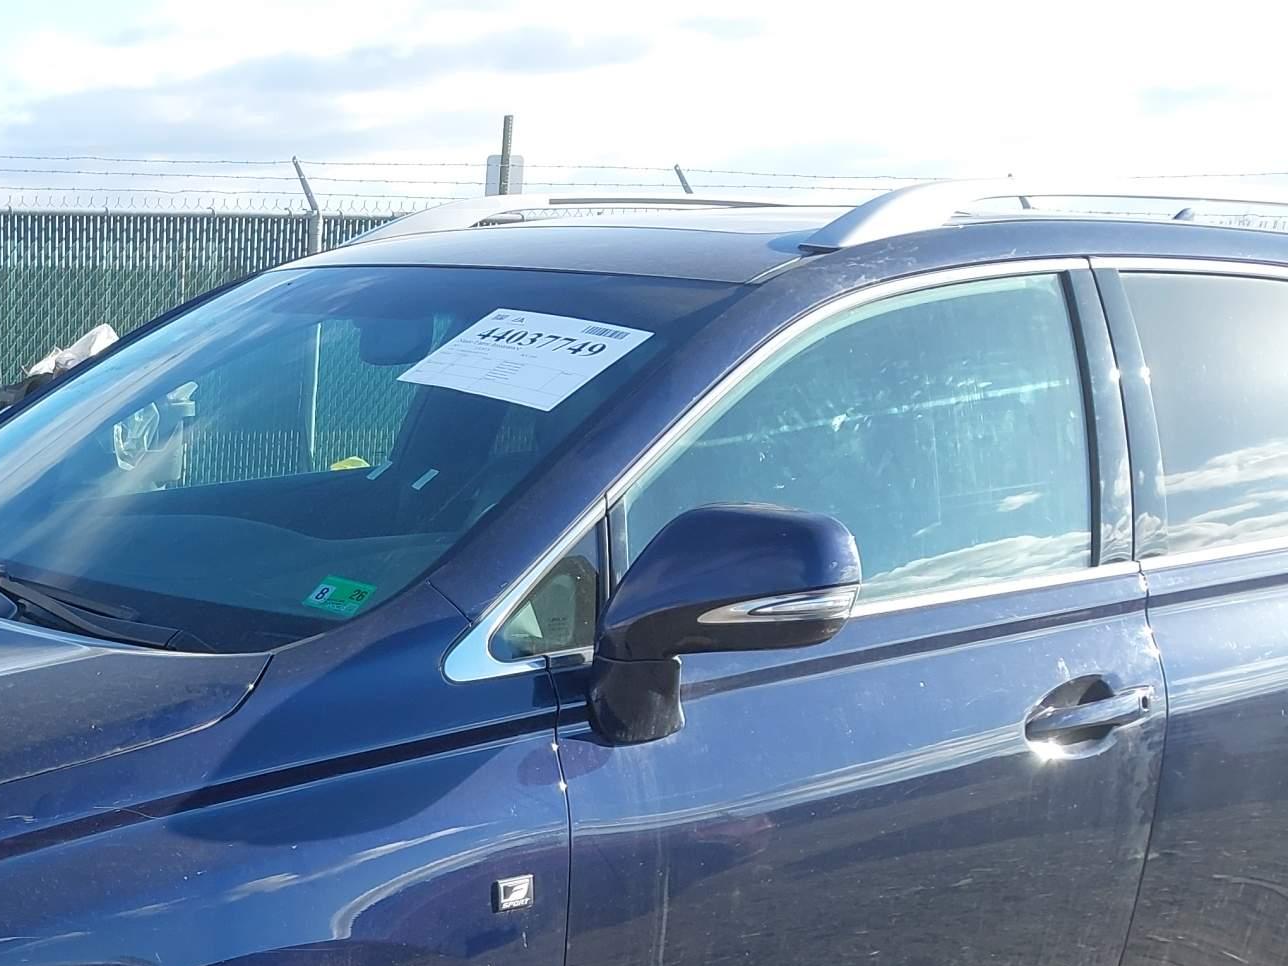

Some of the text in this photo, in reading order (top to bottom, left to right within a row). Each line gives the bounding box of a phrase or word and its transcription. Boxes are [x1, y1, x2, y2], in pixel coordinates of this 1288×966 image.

[478, 327, 606, 357] 44037749
[315, 587, 368, 601] 8 26
[501, 897, 530, 909] SPORT
